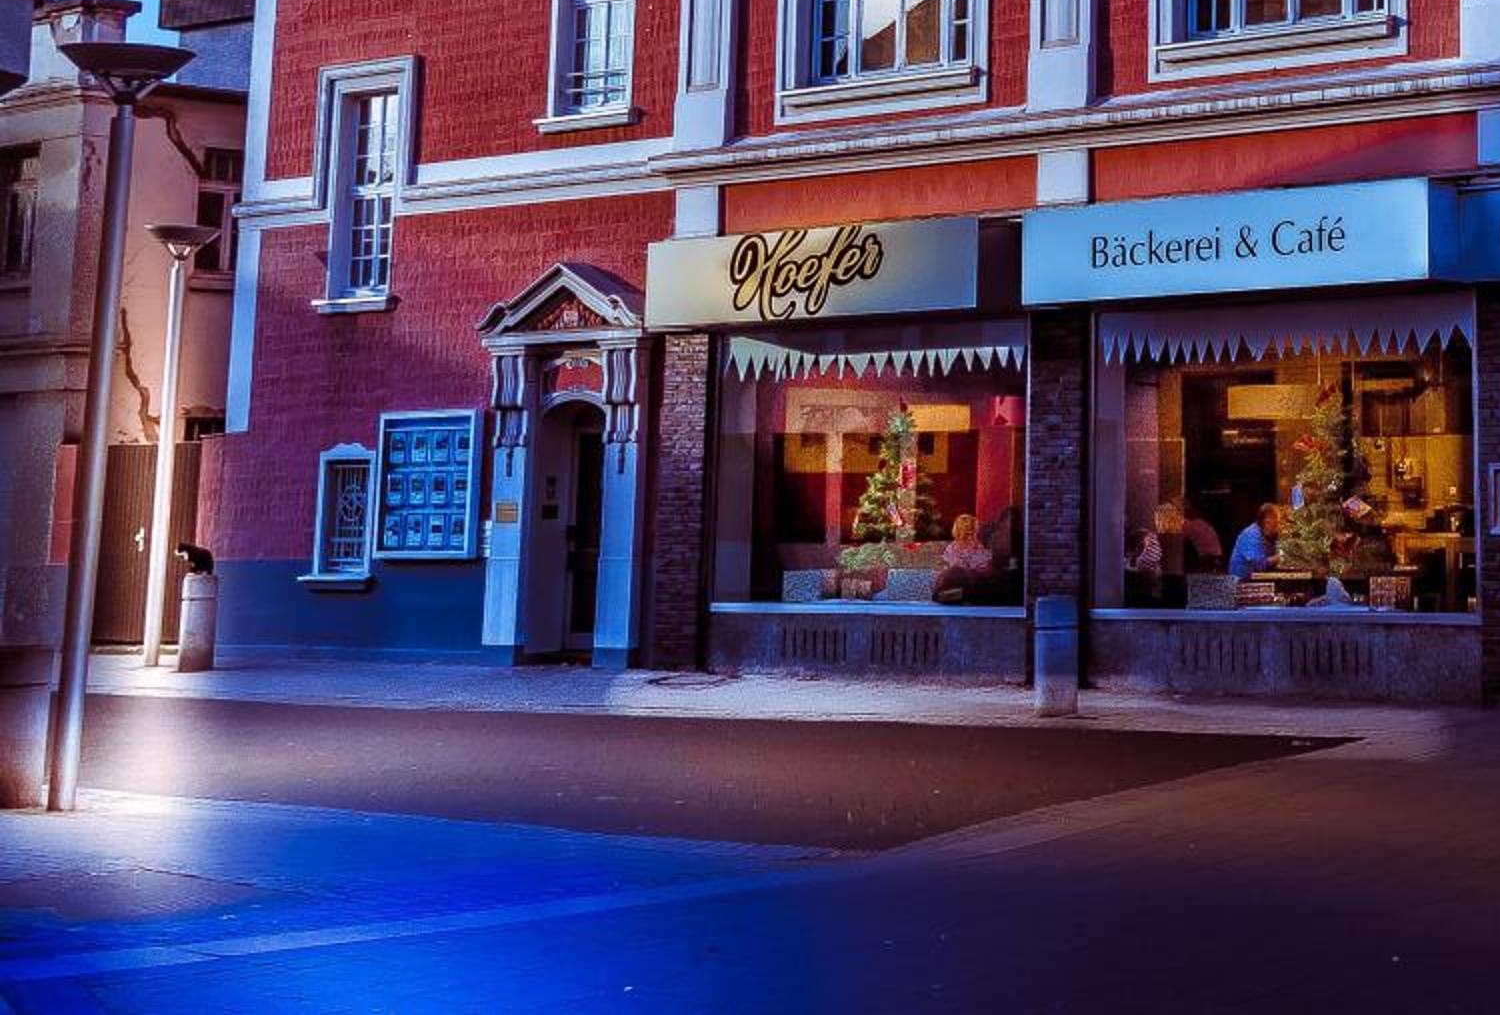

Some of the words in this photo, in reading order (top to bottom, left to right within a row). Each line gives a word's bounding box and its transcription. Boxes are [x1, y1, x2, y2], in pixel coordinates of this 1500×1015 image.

[730, 226, 884, 322] Hoefer
[1091, 227, 1221, 269] Bäckerei
[1235, 225, 1258, 259] &
[1271, 216, 1346, 256] Café
